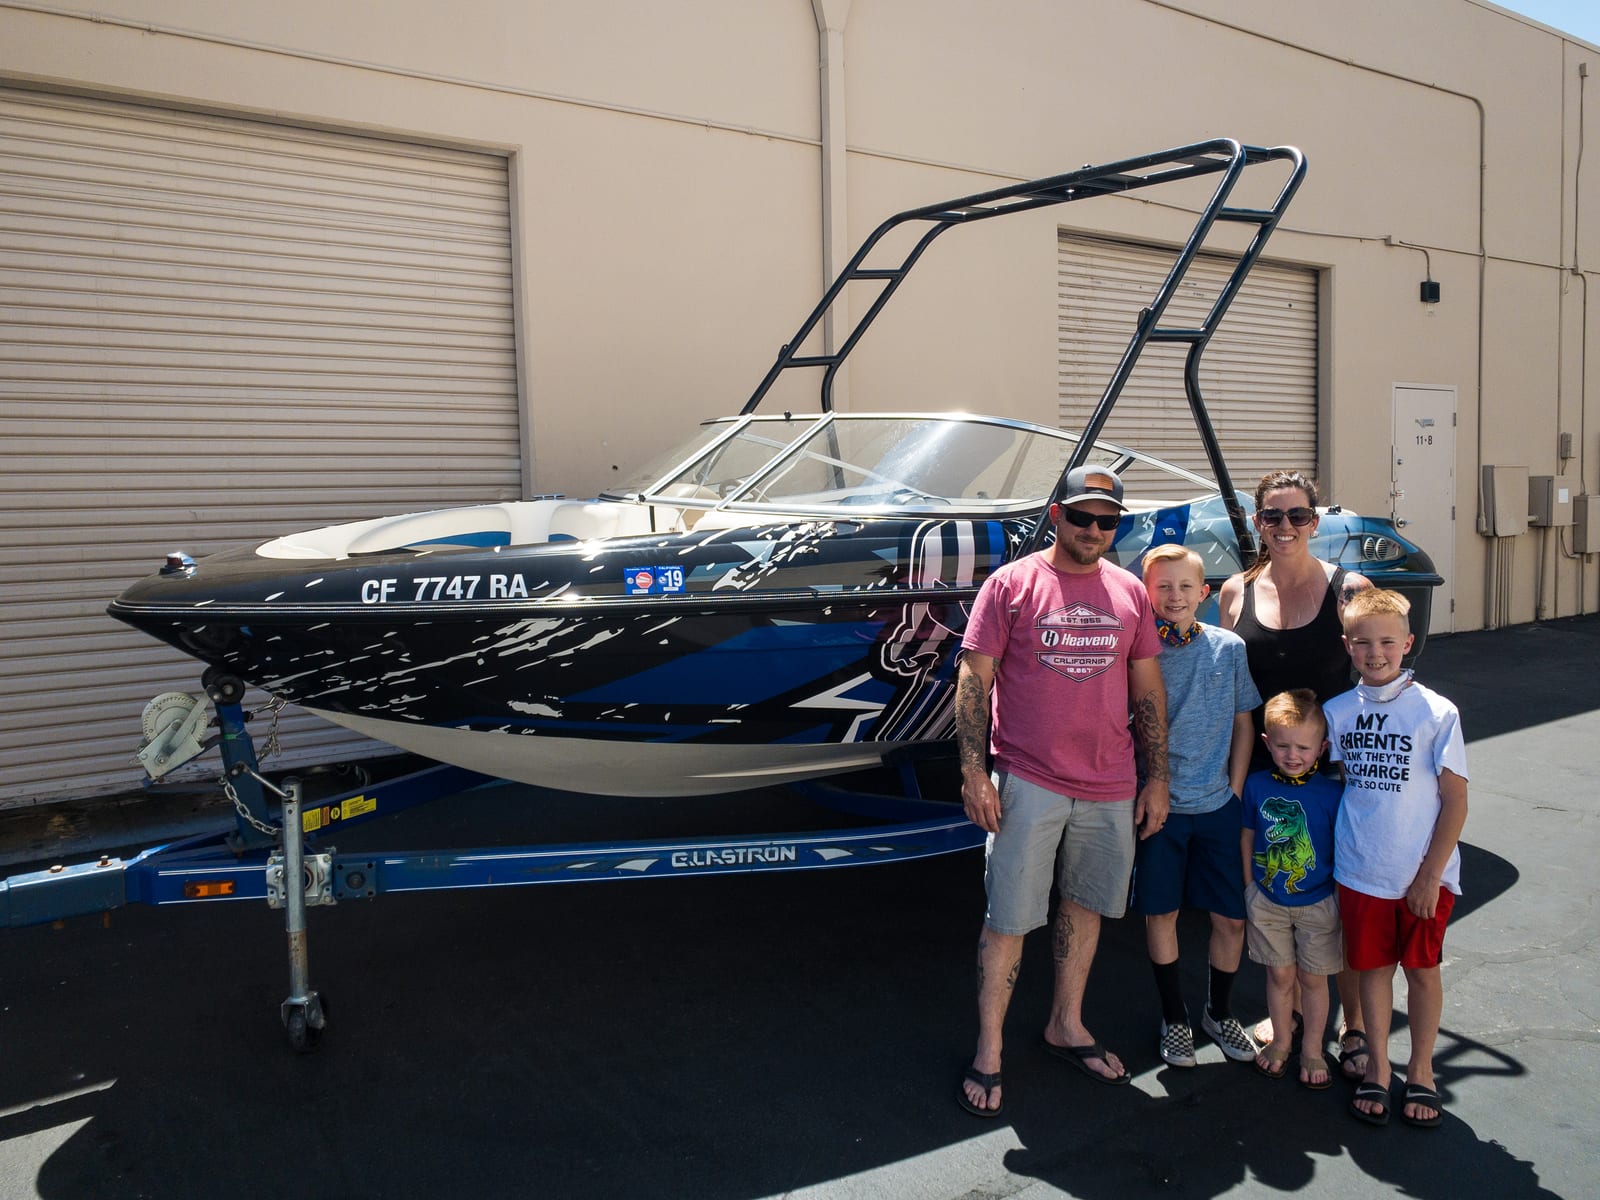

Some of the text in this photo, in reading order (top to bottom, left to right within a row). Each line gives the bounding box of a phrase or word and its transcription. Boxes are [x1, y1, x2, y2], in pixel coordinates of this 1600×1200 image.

[664, 569, 683, 587] 19
[361, 573, 529, 604] CF 7747 RA
[1061, 633, 1119, 649] Heavenly
[1053, 657, 1107, 665] CALIFORNIA
[1355, 712, 1389, 731] MY
[1340, 732, 1413, 752] PARENTS
[1365, 751, 1410, 765] THEY'RE
[1351, 763, 1410, 781] CHARGE
[1364, 780, 1376, 790] SO
[1378, 781, 1402, 792] CUTE
[671, 845, 796, 868] GLASTRON
